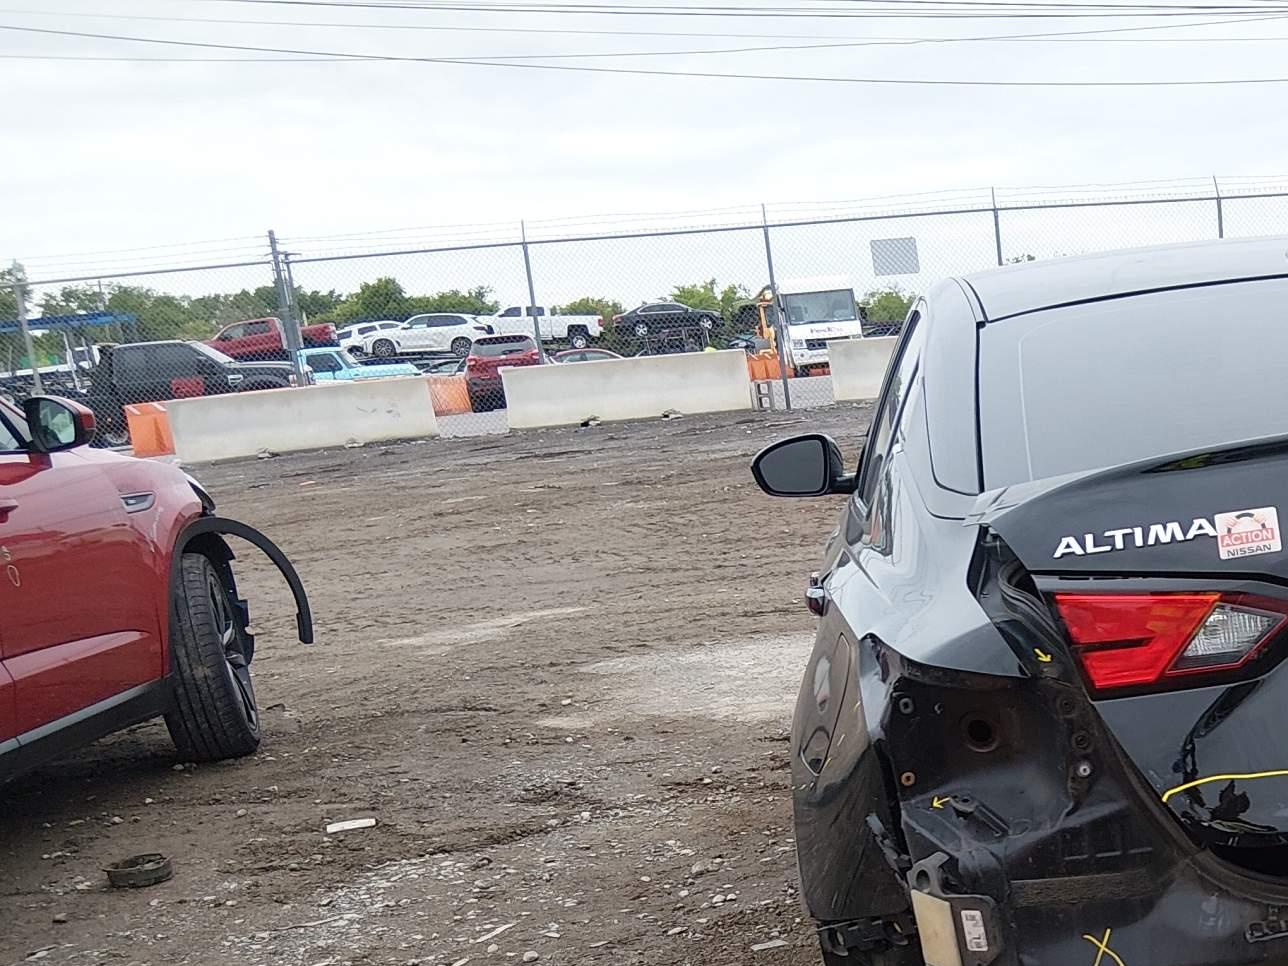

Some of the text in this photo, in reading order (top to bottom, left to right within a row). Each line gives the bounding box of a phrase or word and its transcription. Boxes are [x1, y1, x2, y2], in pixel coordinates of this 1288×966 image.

[1053, 518, 1219, 559] ALTIMA
[1223, 528, 1274, 546] ACTION
[1227, 544, 1272, 557] NISSAN
